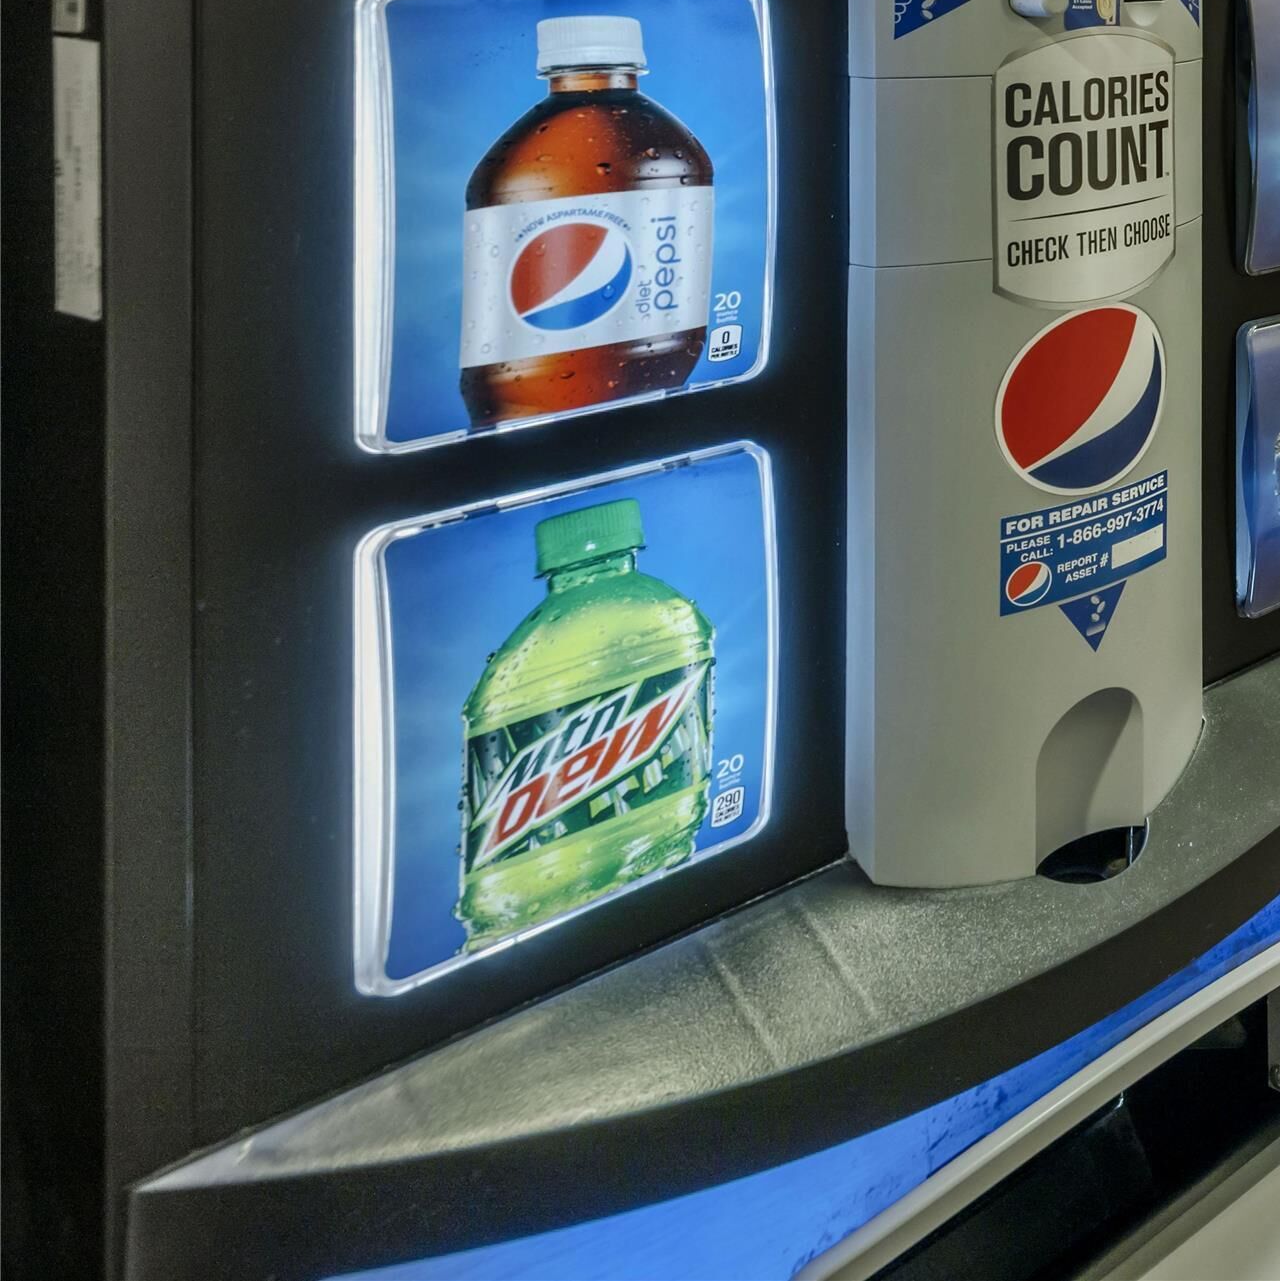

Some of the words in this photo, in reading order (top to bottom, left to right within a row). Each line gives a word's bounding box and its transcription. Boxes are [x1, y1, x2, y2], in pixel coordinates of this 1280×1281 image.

[1005, 70, 1169, 128] CALORIES
[1006, 119, 1169, 201] COUNT
[522, 217, 545, 235] NOW
[546, 208, 604, 223] ASPARTAME
[604, 212, 624, 227] FREE
[1007, 235, 1069, 267] CHECK
[1076, 226, 1117, 256] THEN
[1124, 213, 1170, 247] CHOOSE
[651, 216, 681, 311] pepsi
[635, 279, 652, 313] diet
[713, 291, 741, 311] 20
[722, 331, 730, 344] 0
[1006, 515, 1043, 535] FOR
[1049, 497, 1108, 524] REPAIR
[1111, 475, 1165, 505] SERVICE
[1057, 498, 1164, 548] 1-866-997-3774
[1006, 535, 1050, 554] PLEASE
[1020, 548, 1054, 563] CALL:
[1057, 552, 1098, 573] REPORT
[1100, 552, 1109, 568] #
[1065, 564, 1098, 583] ASSET
[717, 754, 744, 779] 20
[717, 790, 741, 810] 290
